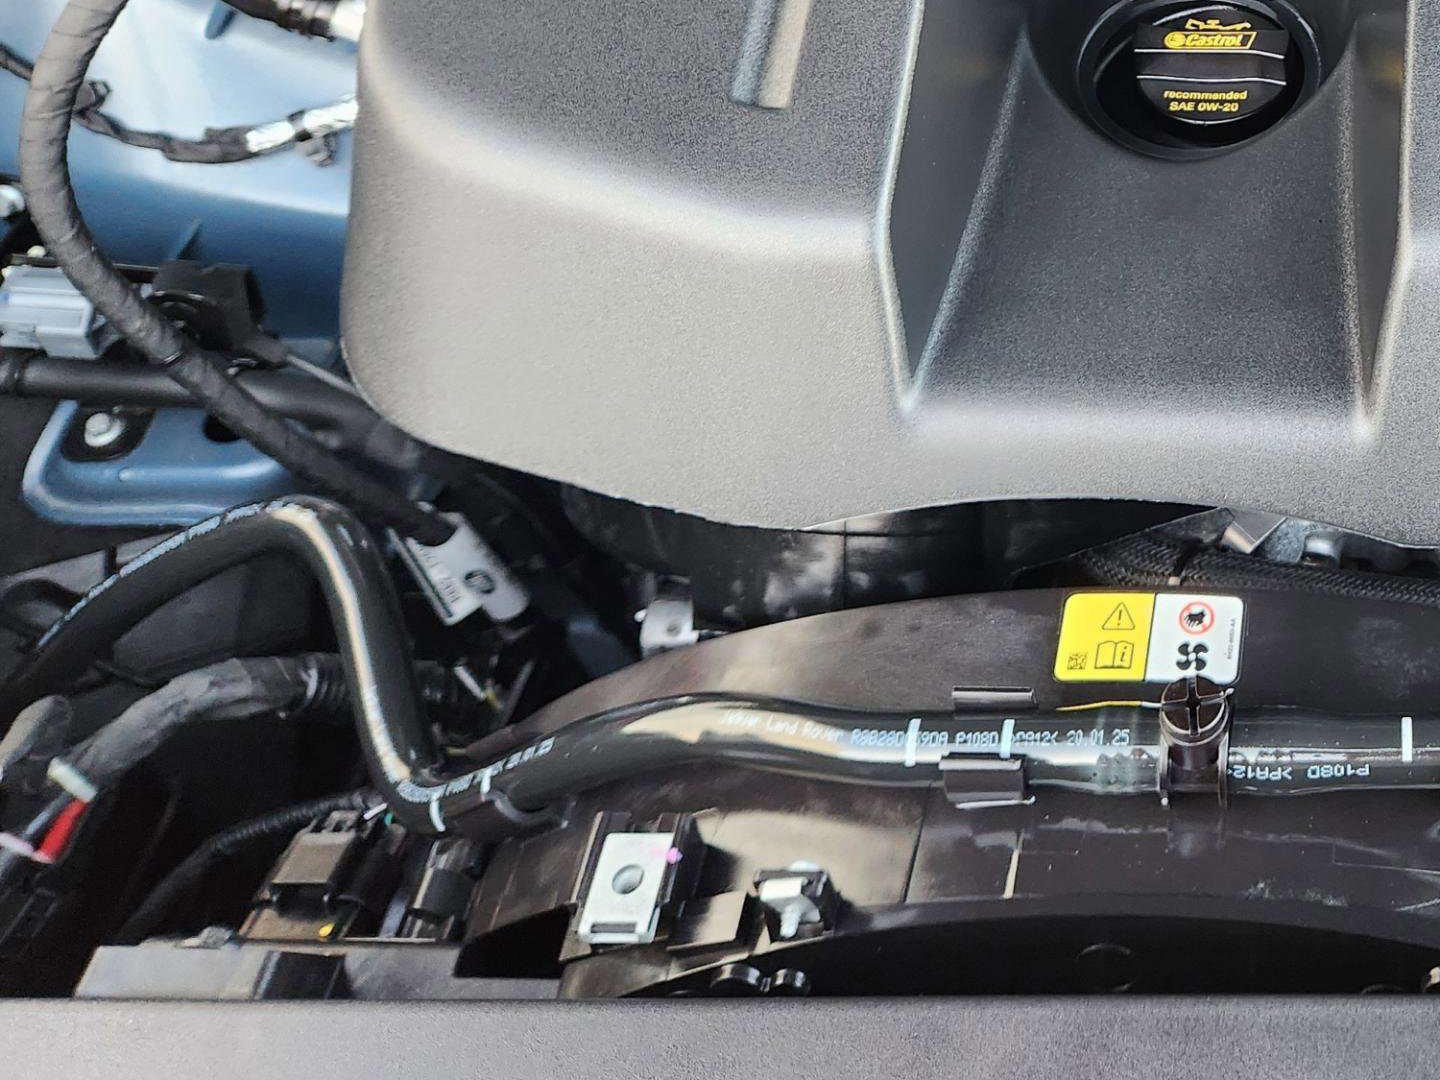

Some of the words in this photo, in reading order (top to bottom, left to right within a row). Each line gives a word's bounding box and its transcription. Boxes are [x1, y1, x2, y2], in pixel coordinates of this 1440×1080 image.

[1185, 34, 1244, 47] Castrol
[1163, 89, 1248, 100] recommended
[1169, 101, 1195, 112] SAE
[1197, 102, 1240, 113] 0W-20
